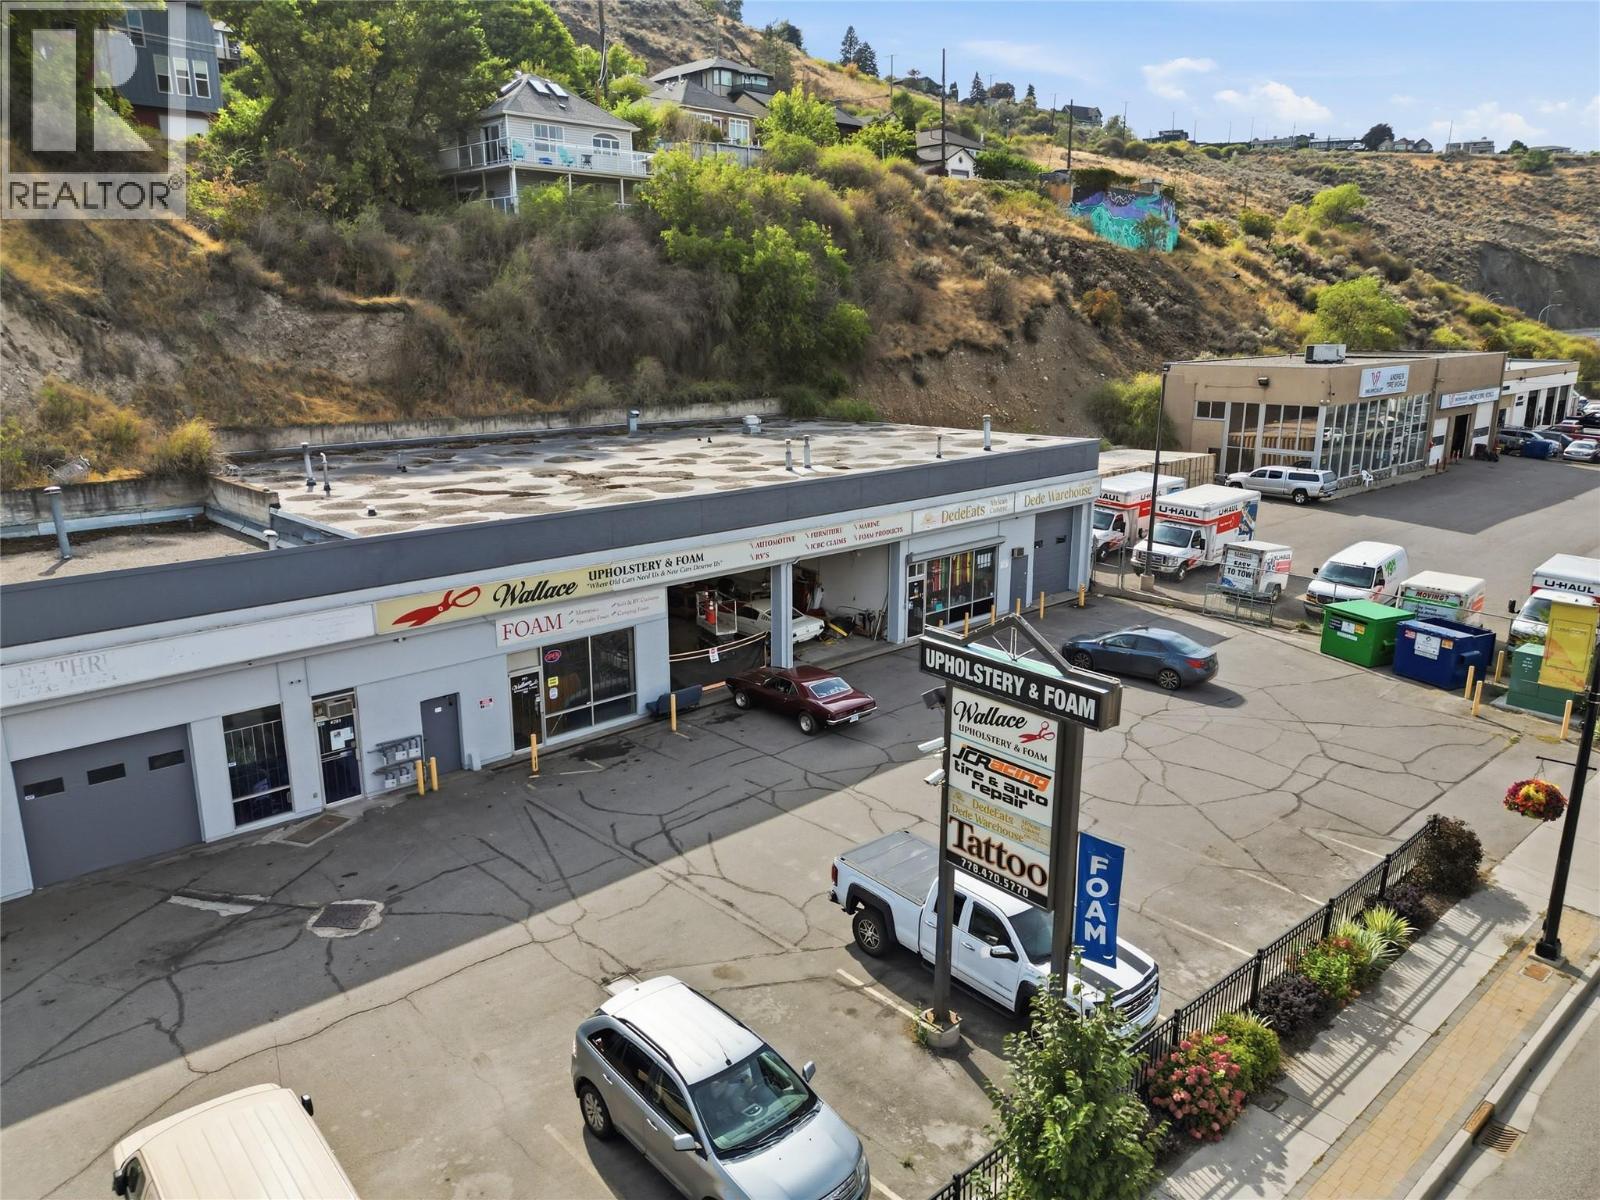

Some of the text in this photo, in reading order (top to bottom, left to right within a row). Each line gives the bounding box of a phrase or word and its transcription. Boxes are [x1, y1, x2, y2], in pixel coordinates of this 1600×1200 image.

[1024, 485, 1092, 507] Dede Warehouse
[941, 504, 986, 524] DedeEats
[1159, 505, 1199, 518] U-HAUL
[1218, 504, 1238, 516] U-HAUL
[810, 527, 842, 539] FURNITURE
[858, 520, 880, 530] MARINE
[858, 527, 904, 541] FOAM PRODUCTS
[755, 535, 796, 549] AUTOMOTIVE
[810, 537, 847, 550] ICBC CLAIMS
[588, 553, 705, 581] UPHOLSTERY & FOAM
[755, 552, 770, 561] RV'S
[609, 579, 621, 587] Old
[622, 576, 635, 584] Cars
[636, 573, 651, 581] Need
[666, 569, 678, 577] New
[679, 566, 692, 574] Cars
[1227, 567, 1253, 578] TO TOW
[493, 579, 578, 608] Wallace
[1415, 591, 1450, 601] MOVING?
[1544, 579, 1595, 594] U-HAUL
[502, 612, 563, 641] FOAM
[925, 647, 1096, 721] UPHOLSTERY & FOAM
[953, 700, 1027, 729] Wallace
[958, 723, 1048, 763] UPHOLSTERY & FOAM
[954, 760, 1049, 807] tire & auto
[971, 780, 1028, 809] repair
[952, 803, 973, 820] Dede
[975, 813, 1024, 843] Warehouse
[972, 799, 1014, 825] DedeEats
[948, 814, 1048, 887] Tattoo
[961, 857, 1029, 898] 778.470.5770
[1084, 855, 1109, 945] FOAM
